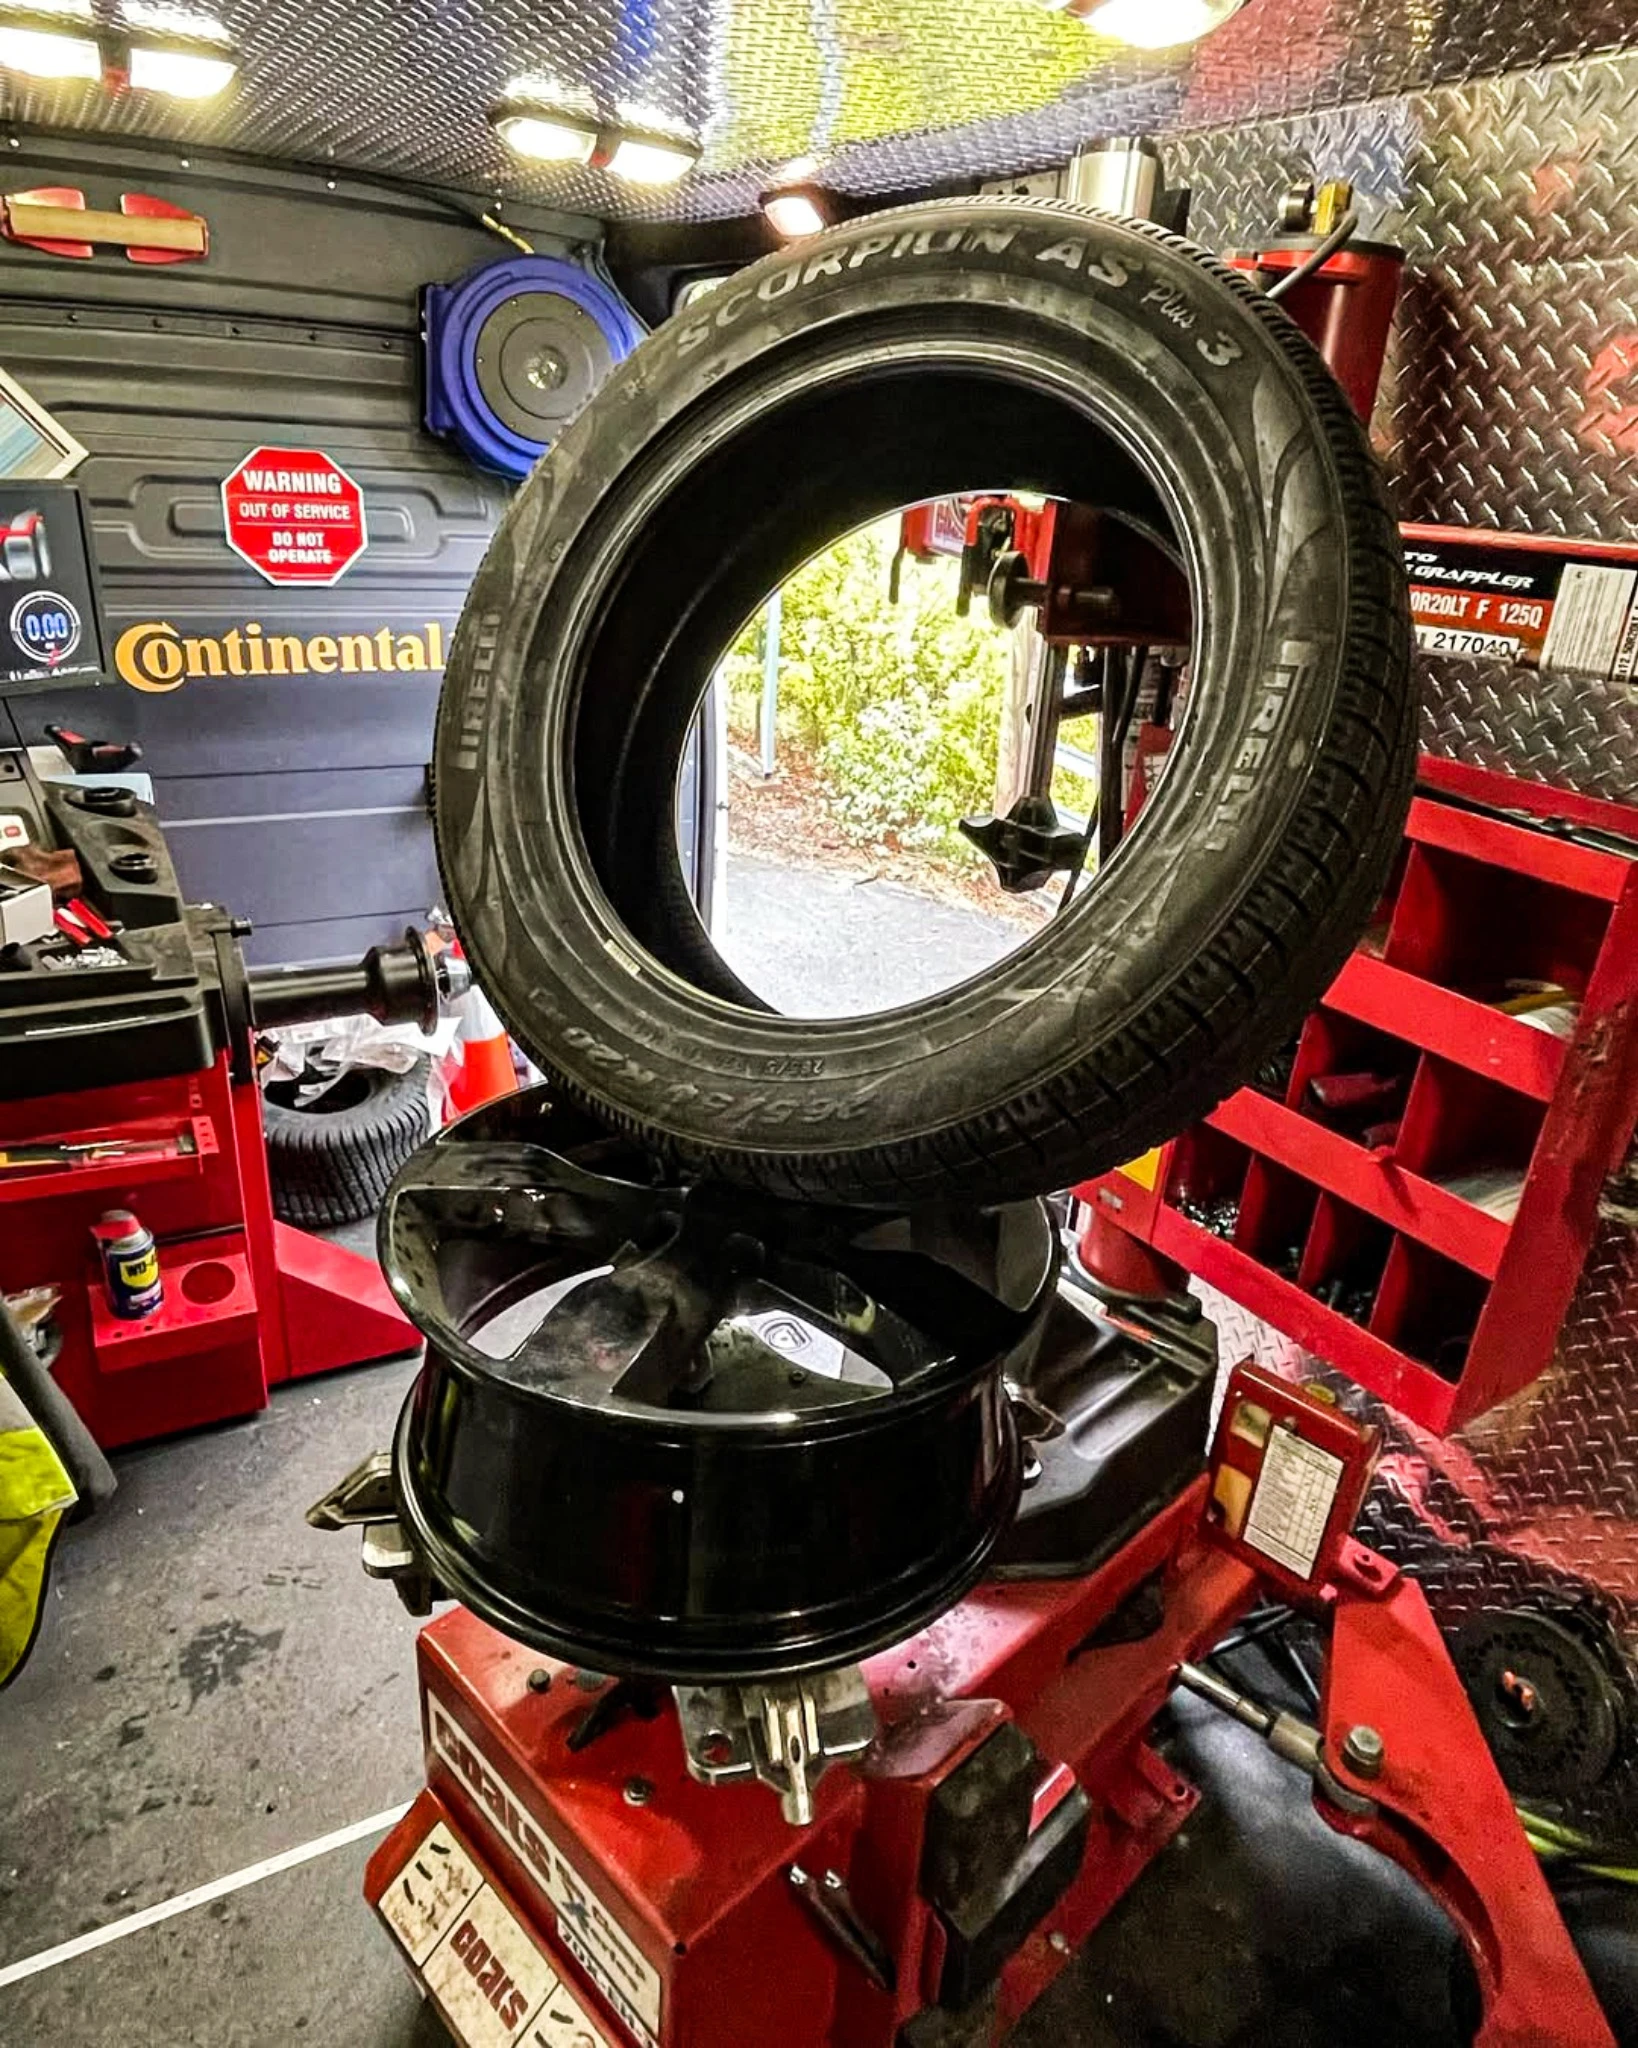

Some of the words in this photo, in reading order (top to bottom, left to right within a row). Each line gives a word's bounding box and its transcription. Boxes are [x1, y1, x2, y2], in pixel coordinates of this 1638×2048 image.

[677, 226, 1024, 359] SCORPION
[1036, 235, 1145, 288] AS
[1141, 278, 1197, 329] Plus
[1196, 330, 1243, 366] 3
[242, 469, 342, 494] WARNING
[239, 503, 267, 518] OUT
[272, 503, 290, 518] OF
[294, 504, 350, 520] SERVICE
[272, 532, 292, 547] DO
[297, 532, 325, 547] NOT
[268, 549, 332, 564] OPERATE
[1415, 564, 1534, 589] GRAPPLER
[1410, 591, 1470, 618] 0R20LT
[1475, 600, 1490, 620] F
[1499, 603, 1544, 630] 125Q
[25, 612, 68, 641] 0.00
[115, 622, 446, 692] Continental
[1433, 632, 1511, 657] 217040
[1204, 640, 1316, 851] PIRELLI
